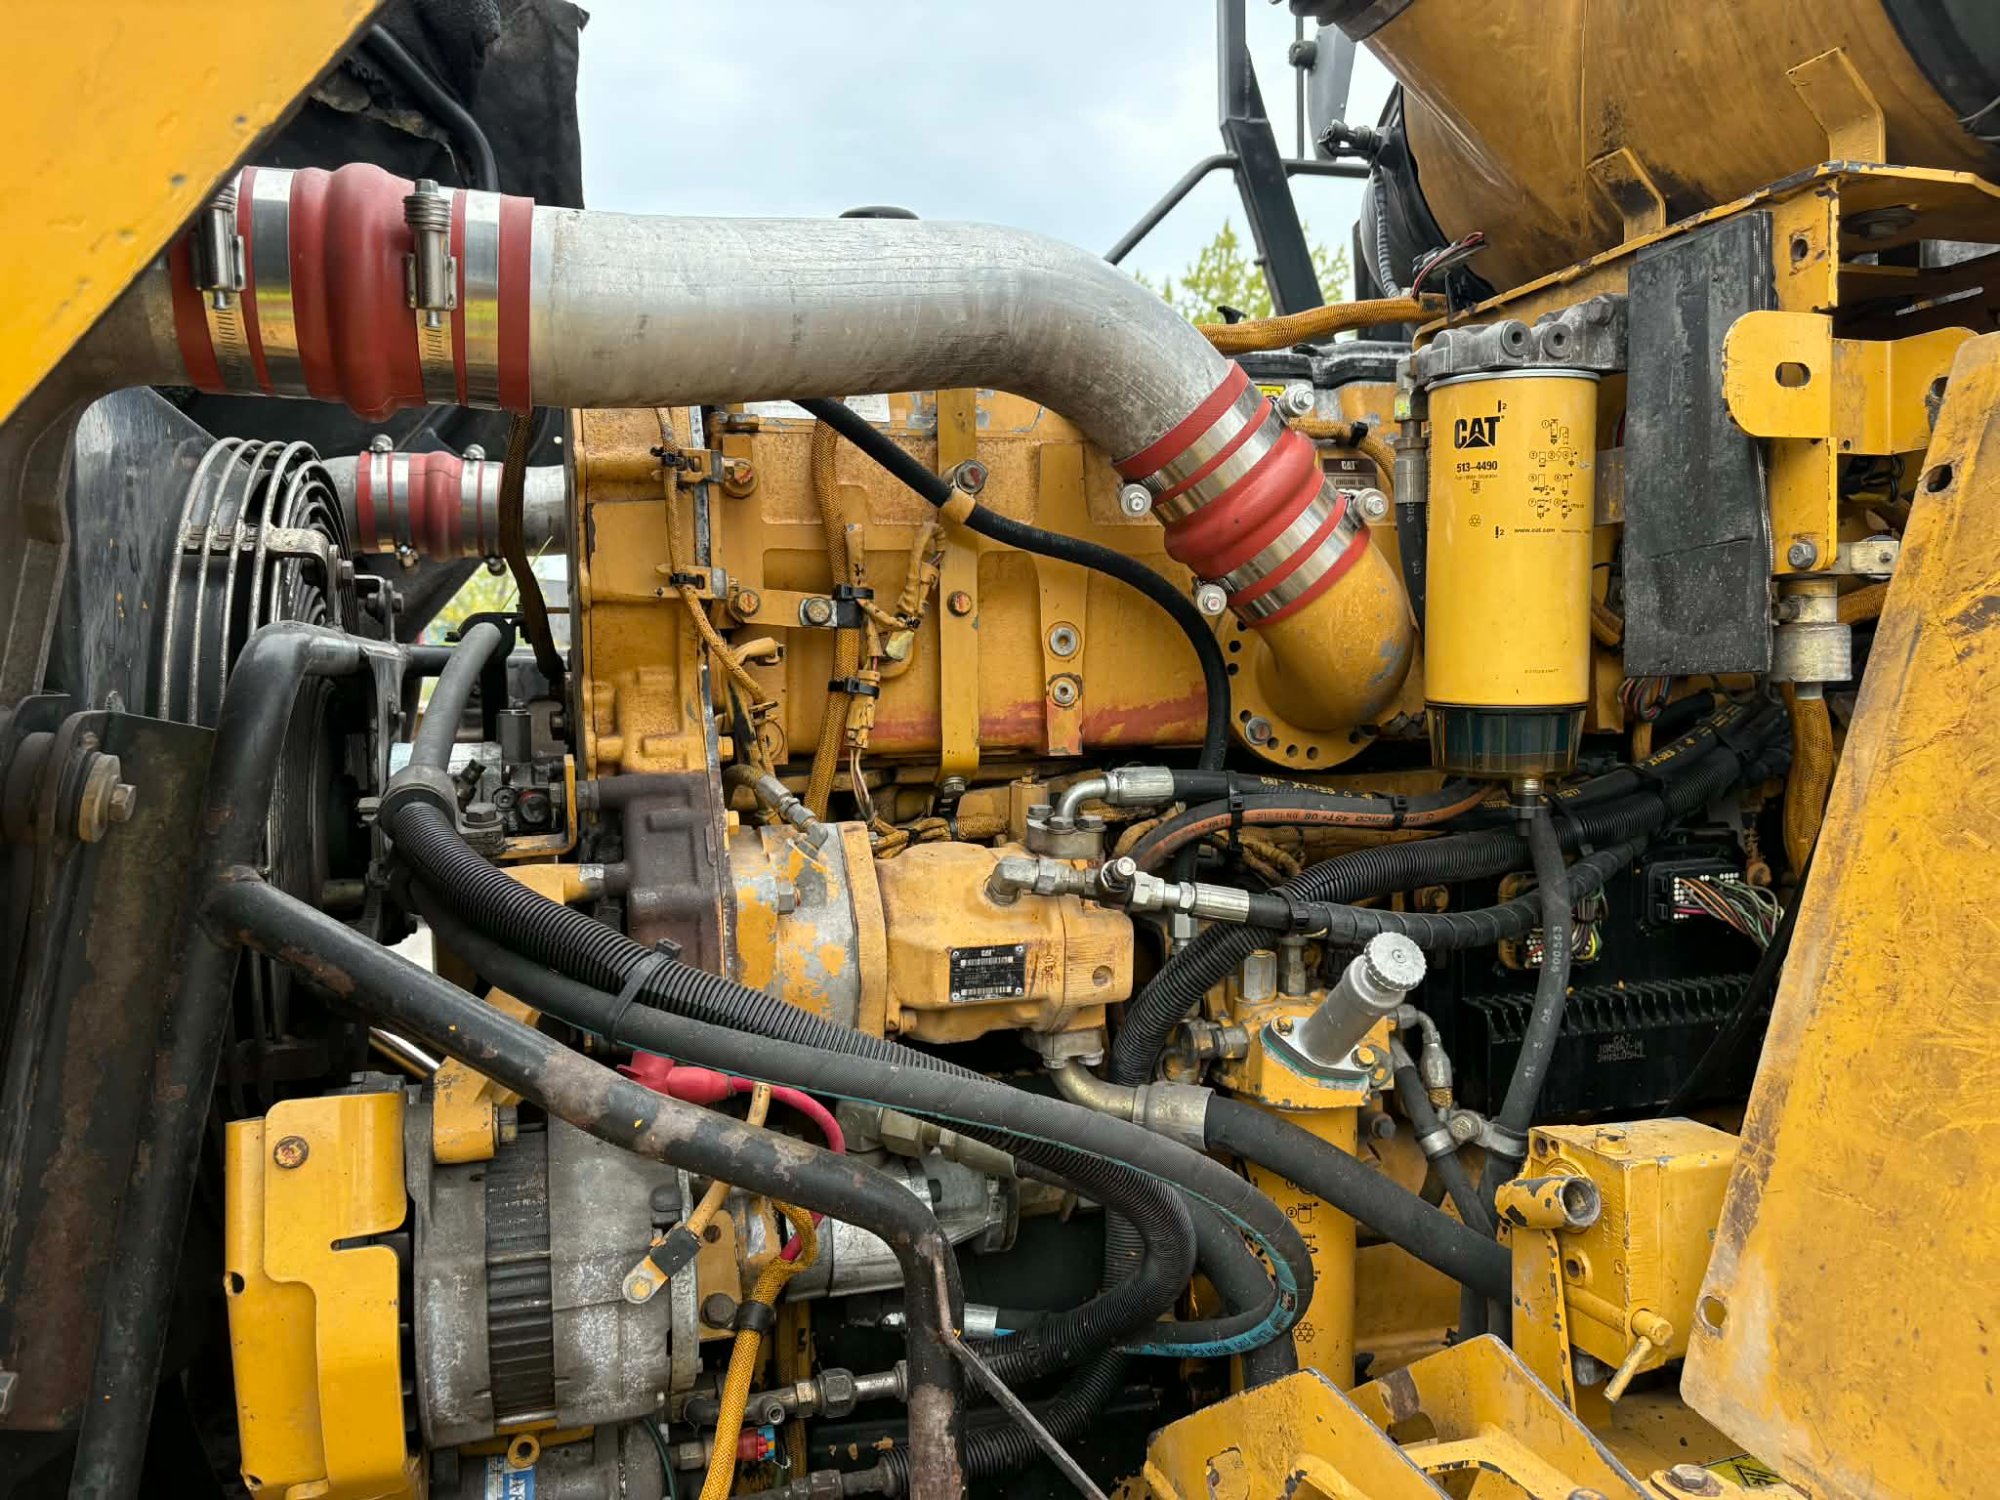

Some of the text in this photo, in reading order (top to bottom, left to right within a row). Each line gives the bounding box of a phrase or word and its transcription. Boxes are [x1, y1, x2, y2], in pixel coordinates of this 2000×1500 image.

[1454, 416, 1501, 449] CAT
[1341, 460, 1356, 470] CAT
[1456, 461, 1498, 473] 513-4490
